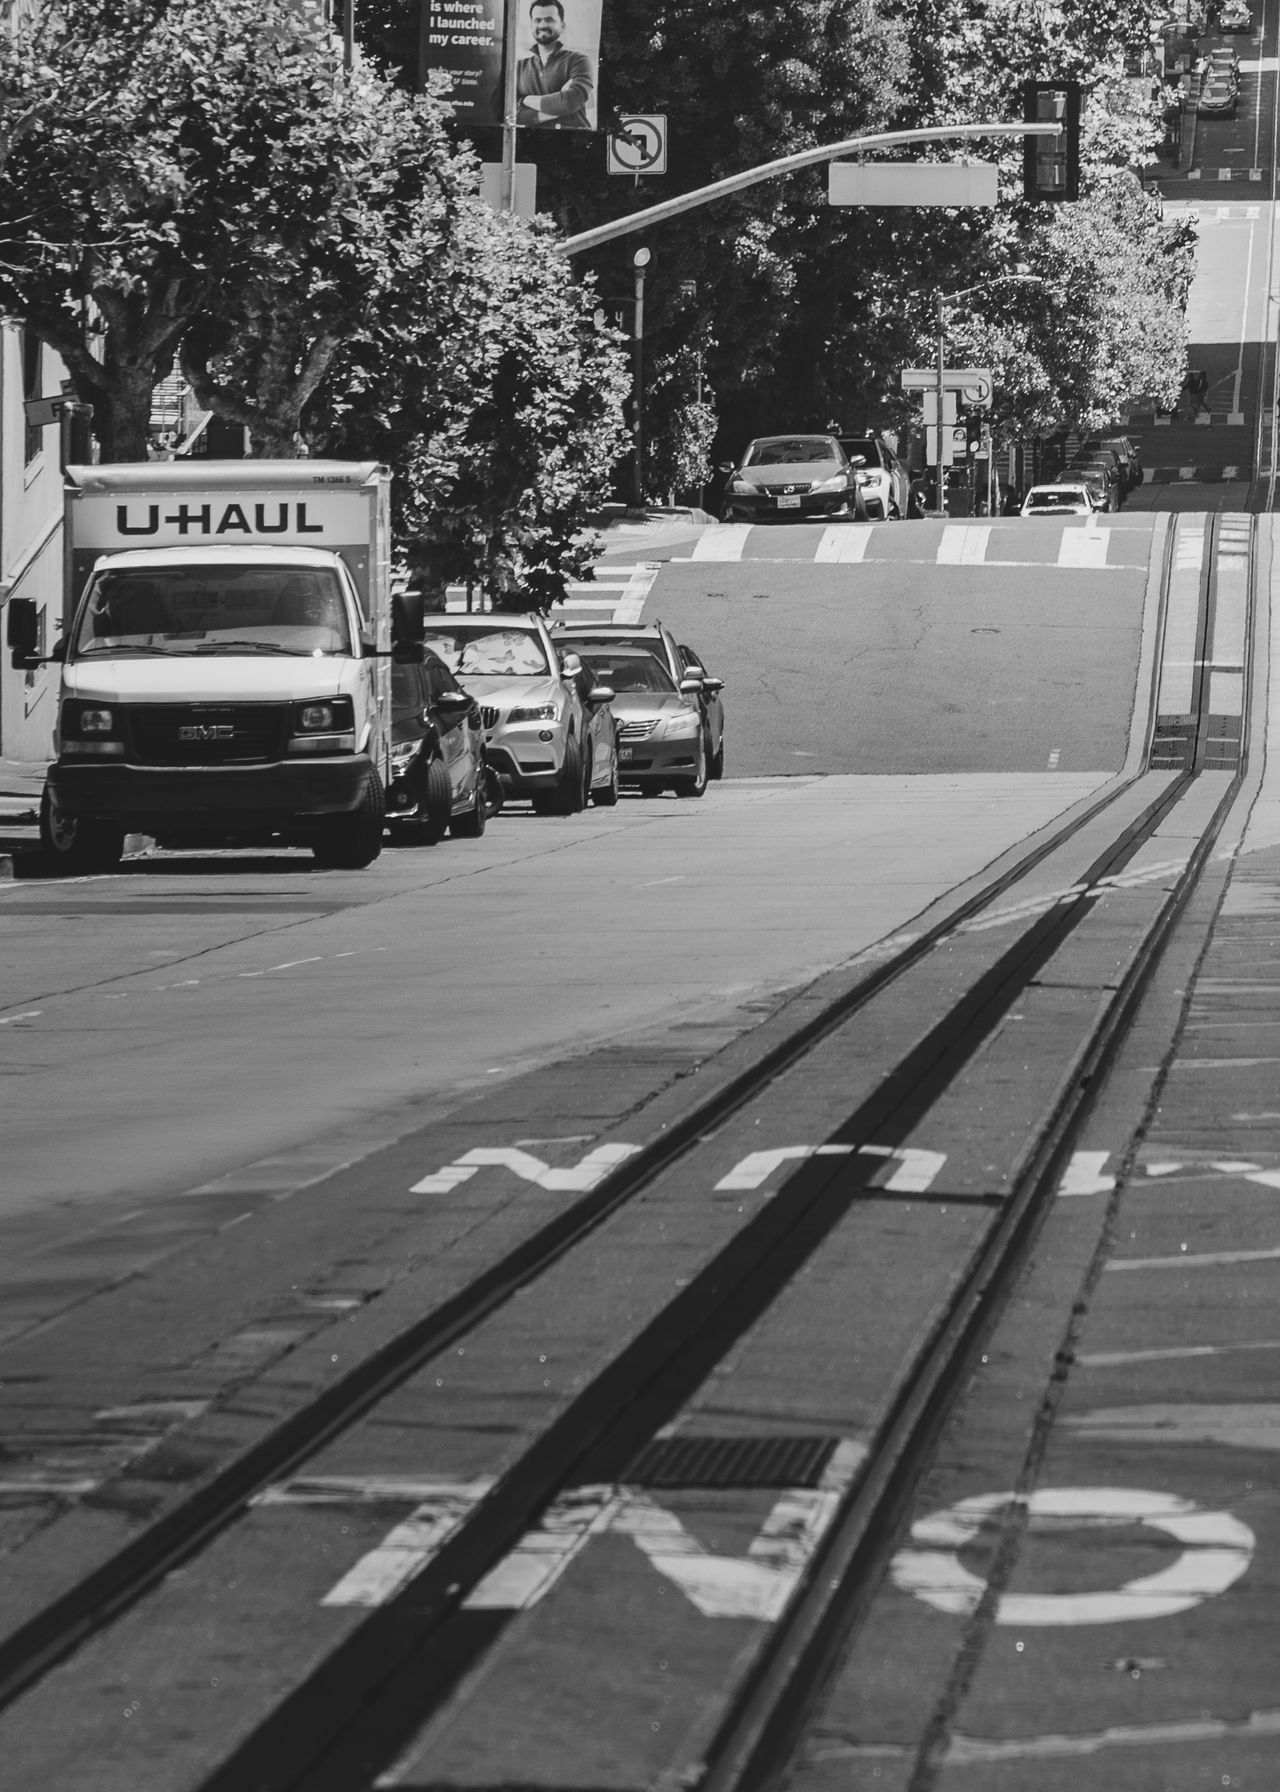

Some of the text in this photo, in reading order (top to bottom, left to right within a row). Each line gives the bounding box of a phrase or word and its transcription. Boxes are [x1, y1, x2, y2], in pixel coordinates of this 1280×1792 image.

[430, 0, 483, 14] is where
[430, 16, 495, 30] I launched
[429, 34, 495, 46] my career.
[117, 503, 324, 536] U-HAUL
[178, 725, 234, 740] GMC
